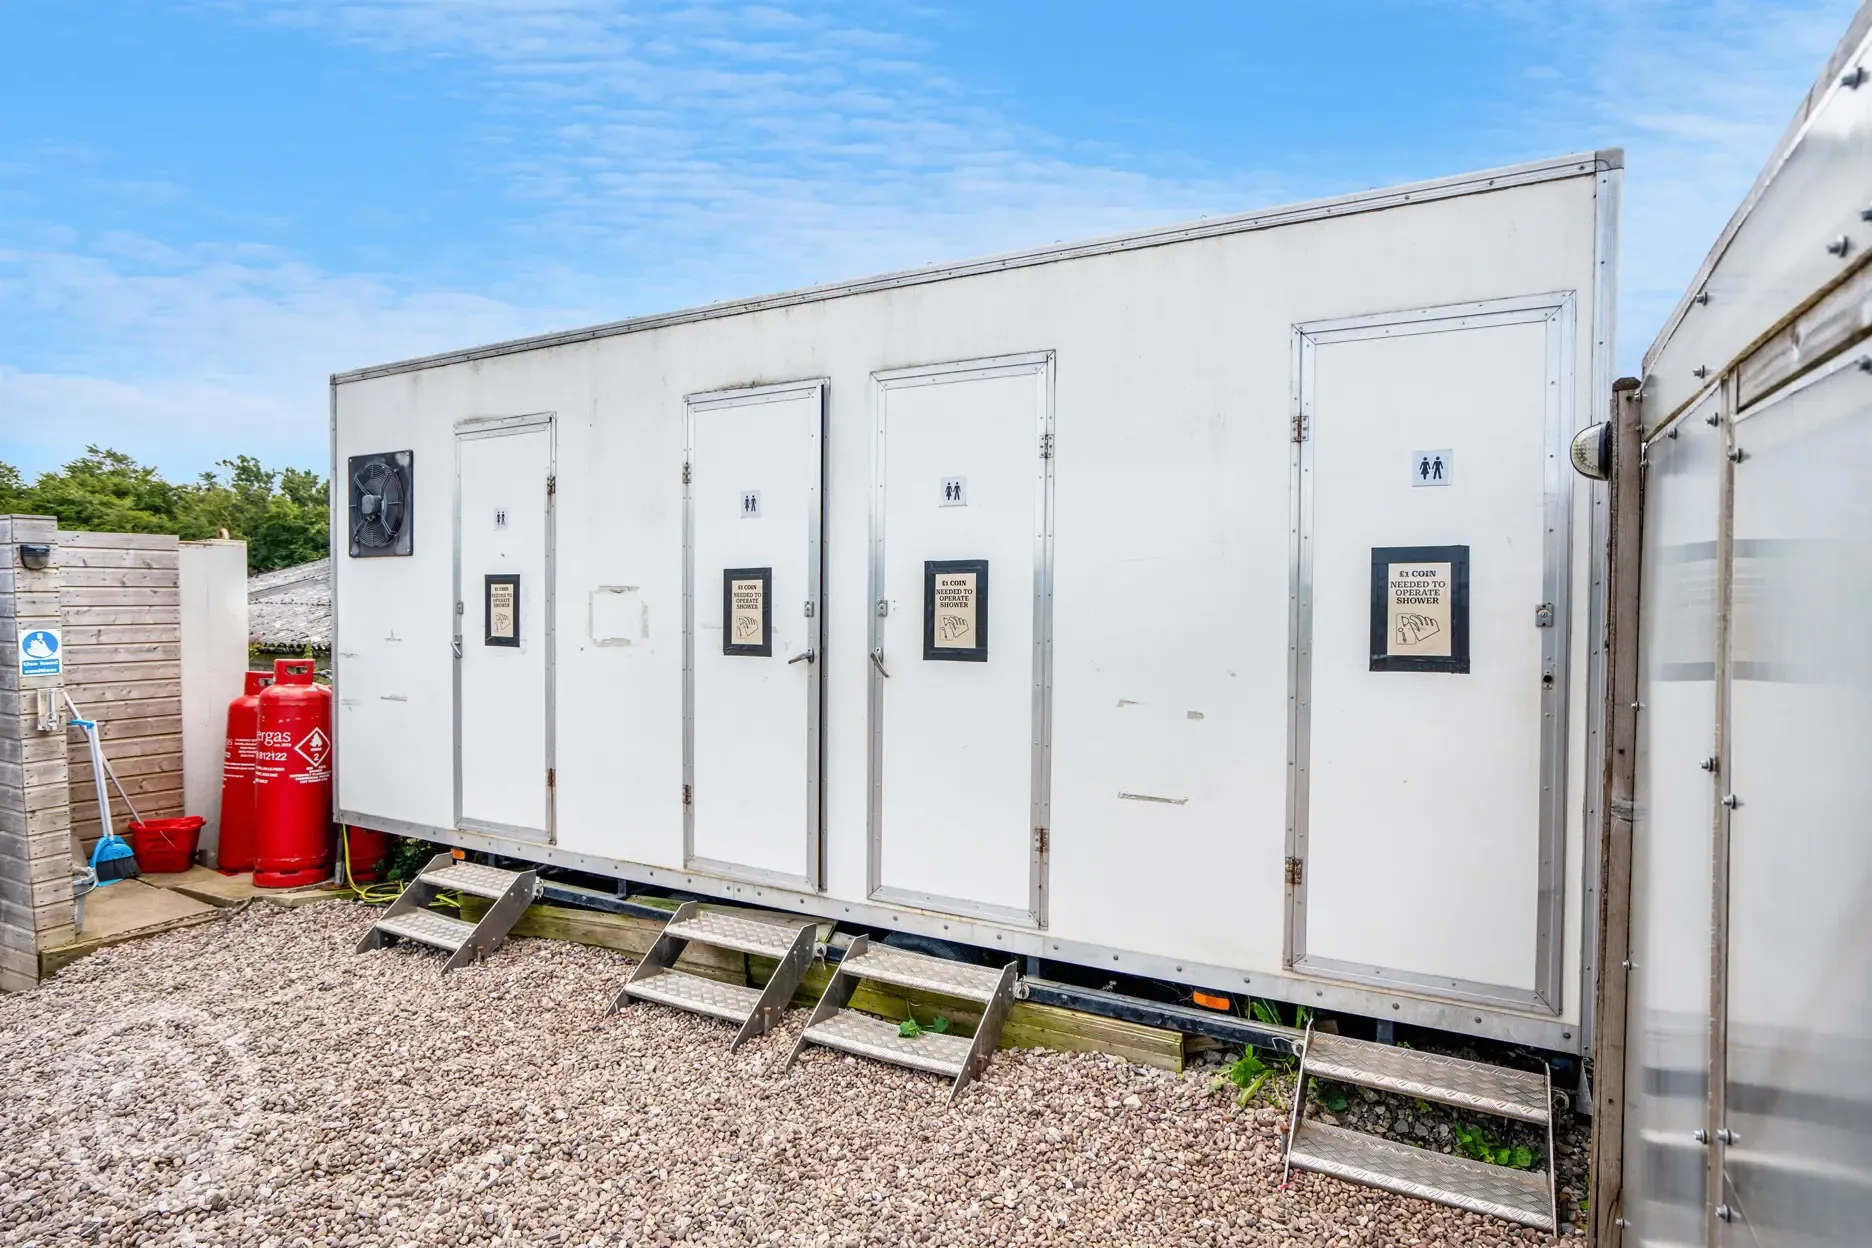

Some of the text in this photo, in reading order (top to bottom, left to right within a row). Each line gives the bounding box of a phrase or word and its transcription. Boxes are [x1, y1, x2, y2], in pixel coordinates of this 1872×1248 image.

[1399, 570, 1437, 578] £1 COIN
[1390, 580, 1446, 588] NEEDED TO
[1395, 588, 1441, 597] OPERATE
[1396, 596, 1440, 605] SHOWER
[313, 753, 320, 761] 2
